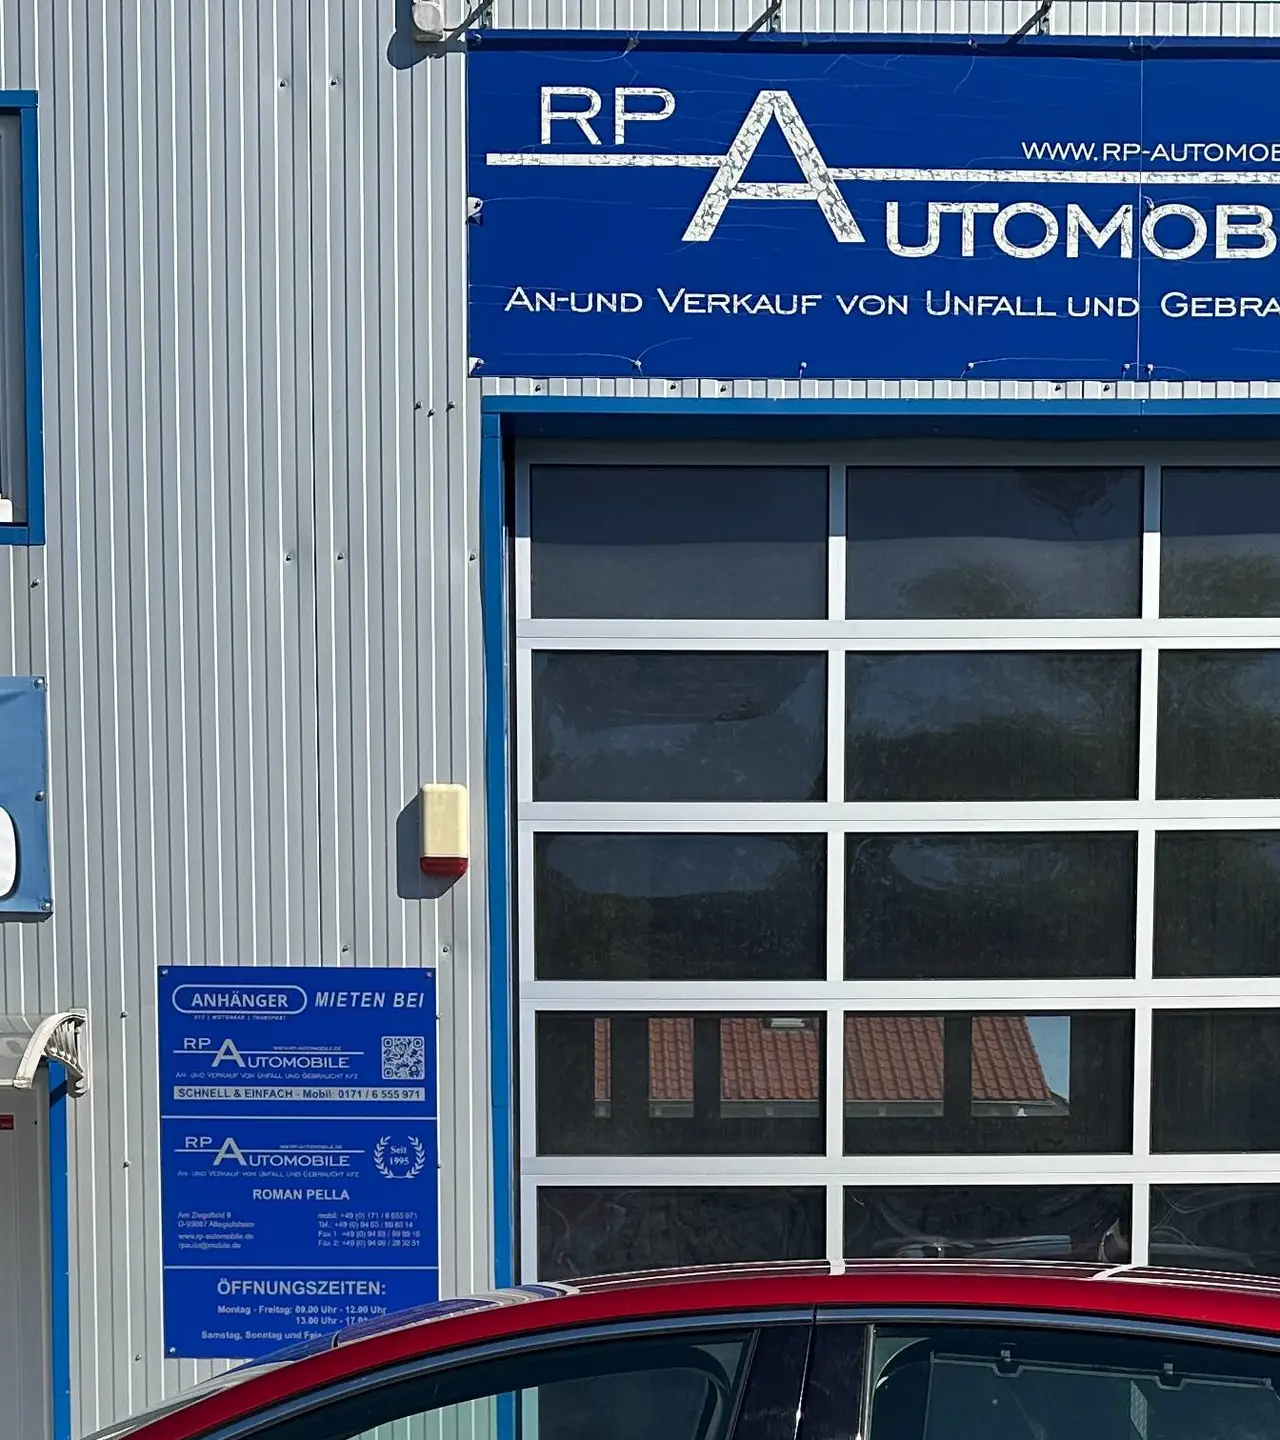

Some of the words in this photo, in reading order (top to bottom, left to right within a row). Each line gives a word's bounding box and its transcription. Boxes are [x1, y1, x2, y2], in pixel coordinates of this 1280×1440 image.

[540, 86, 676, 146] RP
[191, 990, 288, 1008] ANHÄNGER
[314, 991, 386, 1008] MIETEN
[393, 992, 425, 1008] BEI
[183, 1037, 211, 1050] RP
[211, 1038, 350, 1069] AUTOMOBILE
[177, 1088, 231, 1098] SCHNELL
[233, 1088, 242, 1098] &
[244, 1088, 293, 1099] EINFACH
[302, 1089, 335, 1099] Mobil:
[338, 1090, 362, 1099] 0171
[372, 1090, 379, 1099] 6
[381, 1090, 400, 1099] 555
[402, 1090, 420, 1099] 971
[185, 1136, 213, 1148] RP
[213, 1137, 351, 1166] AUTOMOBILE
[390, 1145, 407, 1154] Seit
[389, 1157, 410, 1165] 1995
[252, 1189, 302, 1200] ROMAN
[306, 1189, 350, 1201] PELLA
[217, 1278, 386, 1295] ÖFFNUNGSZEITEN:
[218, 1305, 251, 1315] Montag
[258, 1305, 293, 1315] Freitag:
[295, 1305, 319, 1314] 09.00
[321, 1305, 337, 1314] Uhr
[345, 1305, 369, 1314] 12.00
[371, 1305, 387, 1314] Uhr
[296, 1317, 319, 1325] 13.00
[321, 1316, 337, 1325] Uhr
[345, 1317, 368, 1325] 17.0
[201, 1330, 243, 1340] Samstag,
[245, 1330, 282, 1340] Sonntag
[284, 1330, 302, 1339] und
